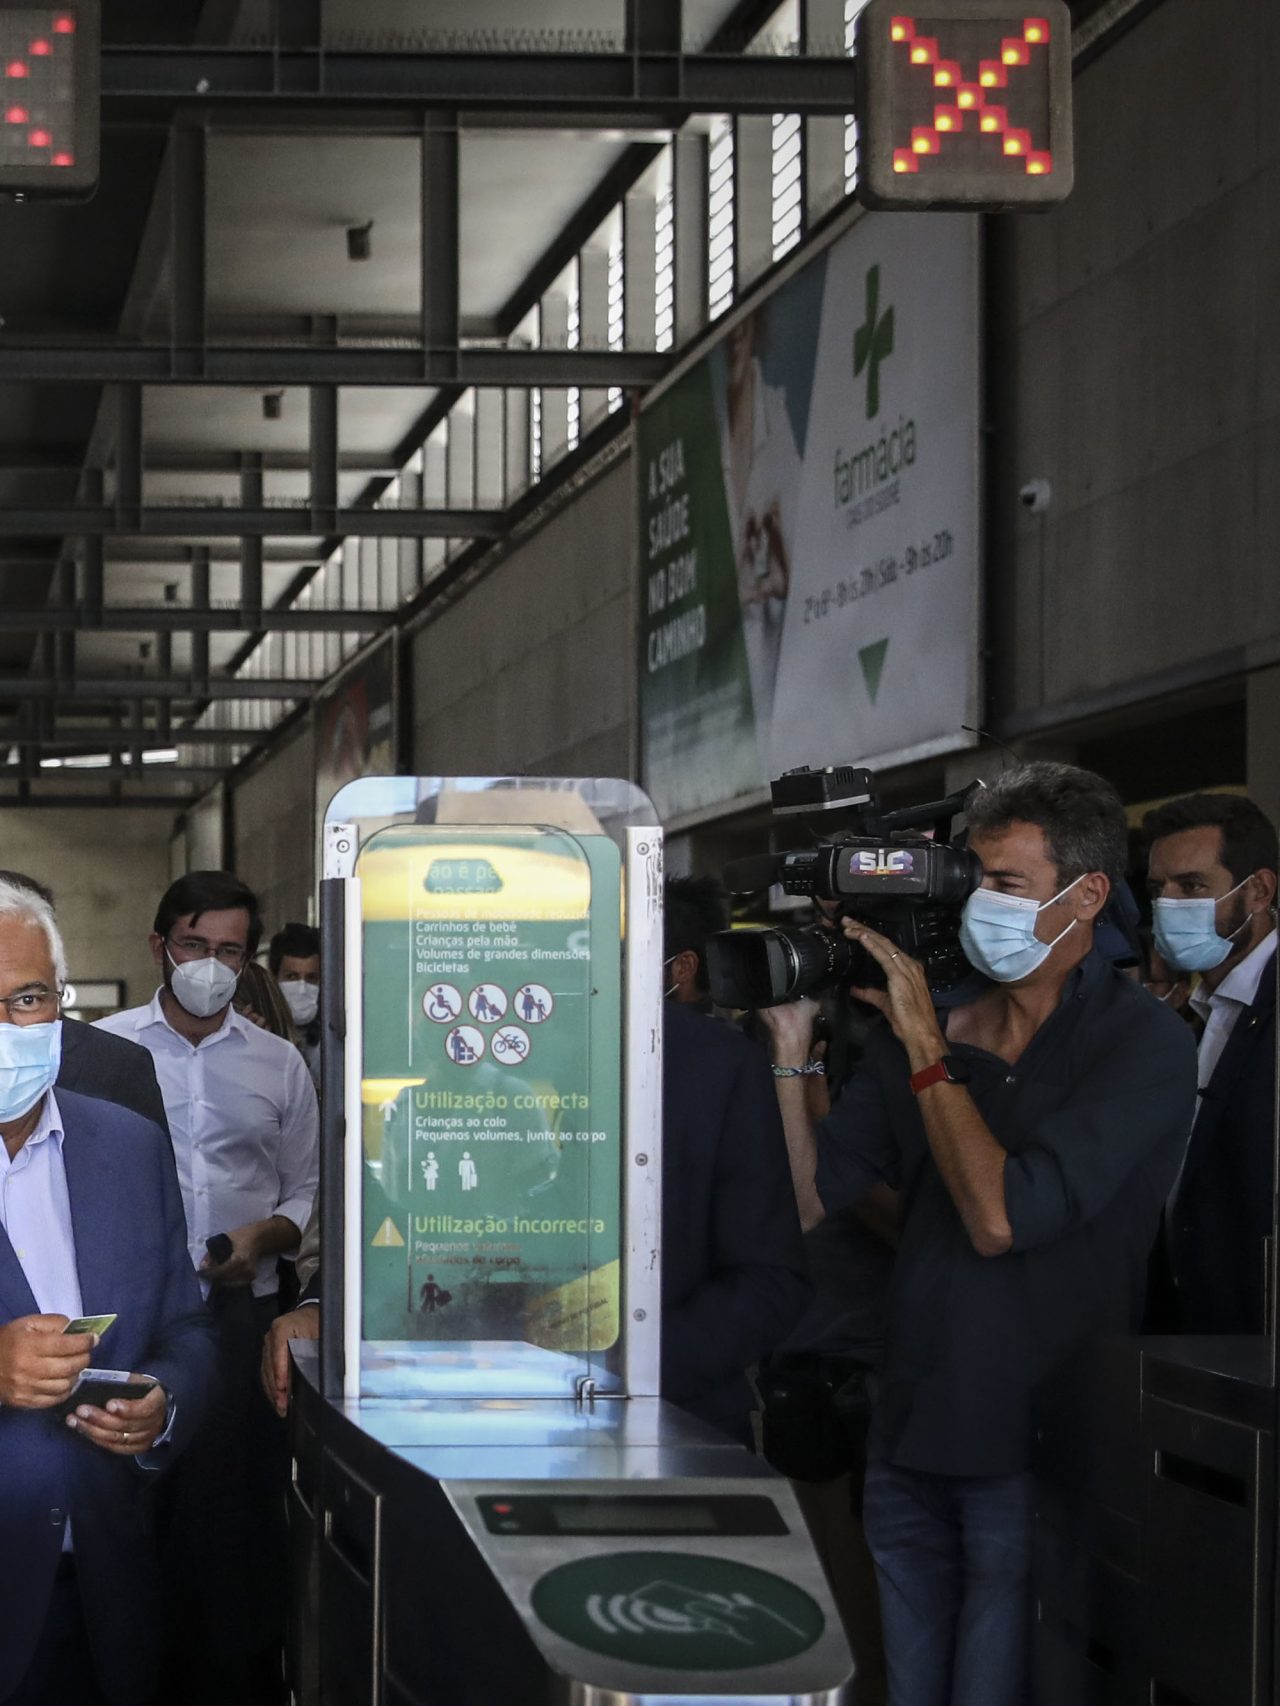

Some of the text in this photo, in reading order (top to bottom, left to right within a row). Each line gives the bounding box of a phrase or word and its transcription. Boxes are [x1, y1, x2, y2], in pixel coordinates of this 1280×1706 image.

[659, 438, 685, 494] SUA
[834, 413, 916, 509] farmácia
[649, 493, 690, 559] SAÚDE
[648, 603, 706, 672] CAMINHO
[416, 921, 517, 932] Carrinhos de bebé
[416, 934, 518, 948] Crianças pela mão
[416, 948, 591, 962] Volumes de grandes dimensões
[416, 962, 470, 974] Bicicletas
[416, 1092, 589, 1112] Utilização correcta
[416, 1116, 506, 1128] Crianças ao colo
[416, 1130, 470, 1143] Pequenos
[526, 1130, 555, 1143] junto
[560, 1132, 573, 1141] ao
[416, 1215, 507, 1237] Utilização
[416, 1240, 469, 1253] Pequenos
